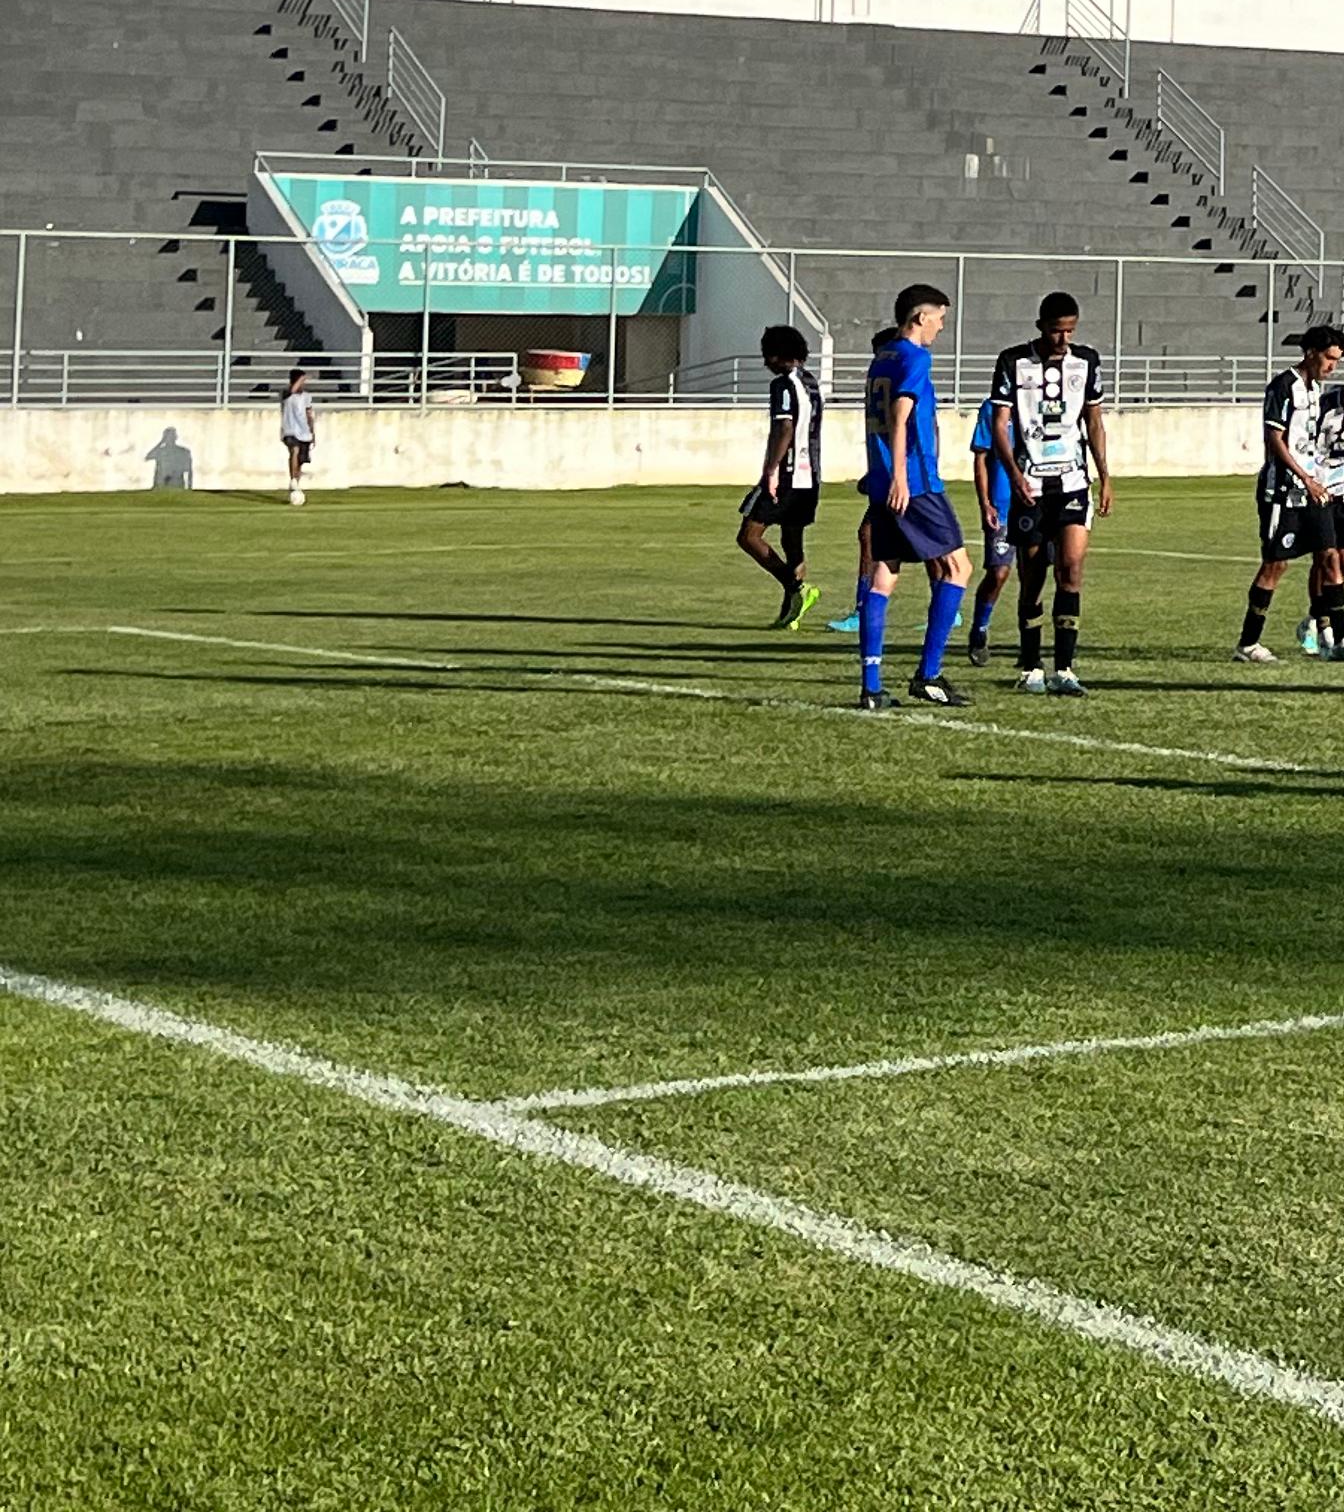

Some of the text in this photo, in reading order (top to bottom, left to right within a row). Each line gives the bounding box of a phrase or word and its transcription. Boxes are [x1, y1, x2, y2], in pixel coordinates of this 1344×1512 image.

[400, 206, 560, 228] A PREFEITURA
[400, 233, 471, 254] APOIA
[476, 235, 493, 253] O
[398, 261, 415, 280] A
[422, 258, 512, 282] VITÓRIA
[518, 260, 532, 282] É
[538, 263, 565, 282] DE
